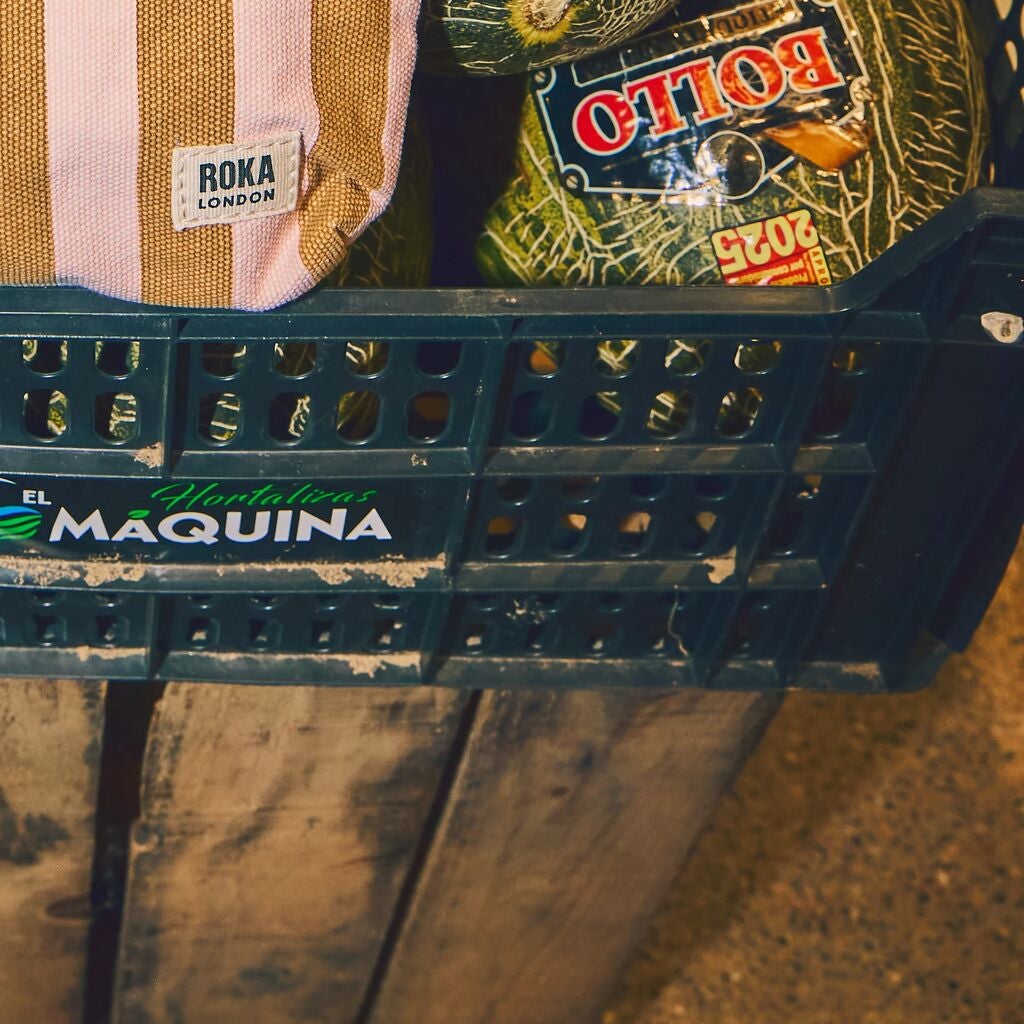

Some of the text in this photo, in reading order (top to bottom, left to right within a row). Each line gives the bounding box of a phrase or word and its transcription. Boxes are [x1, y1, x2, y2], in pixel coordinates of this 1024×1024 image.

[572, 26, 845, 155] BOLLO
[199, 154, 275, 193] ROKA
[198, 188, 275, 209] LONDON
[711, 209, 819, 275] 2025
[22, 489, 52, 506] EL
[151, 482, 377, 512] Hortalizas
